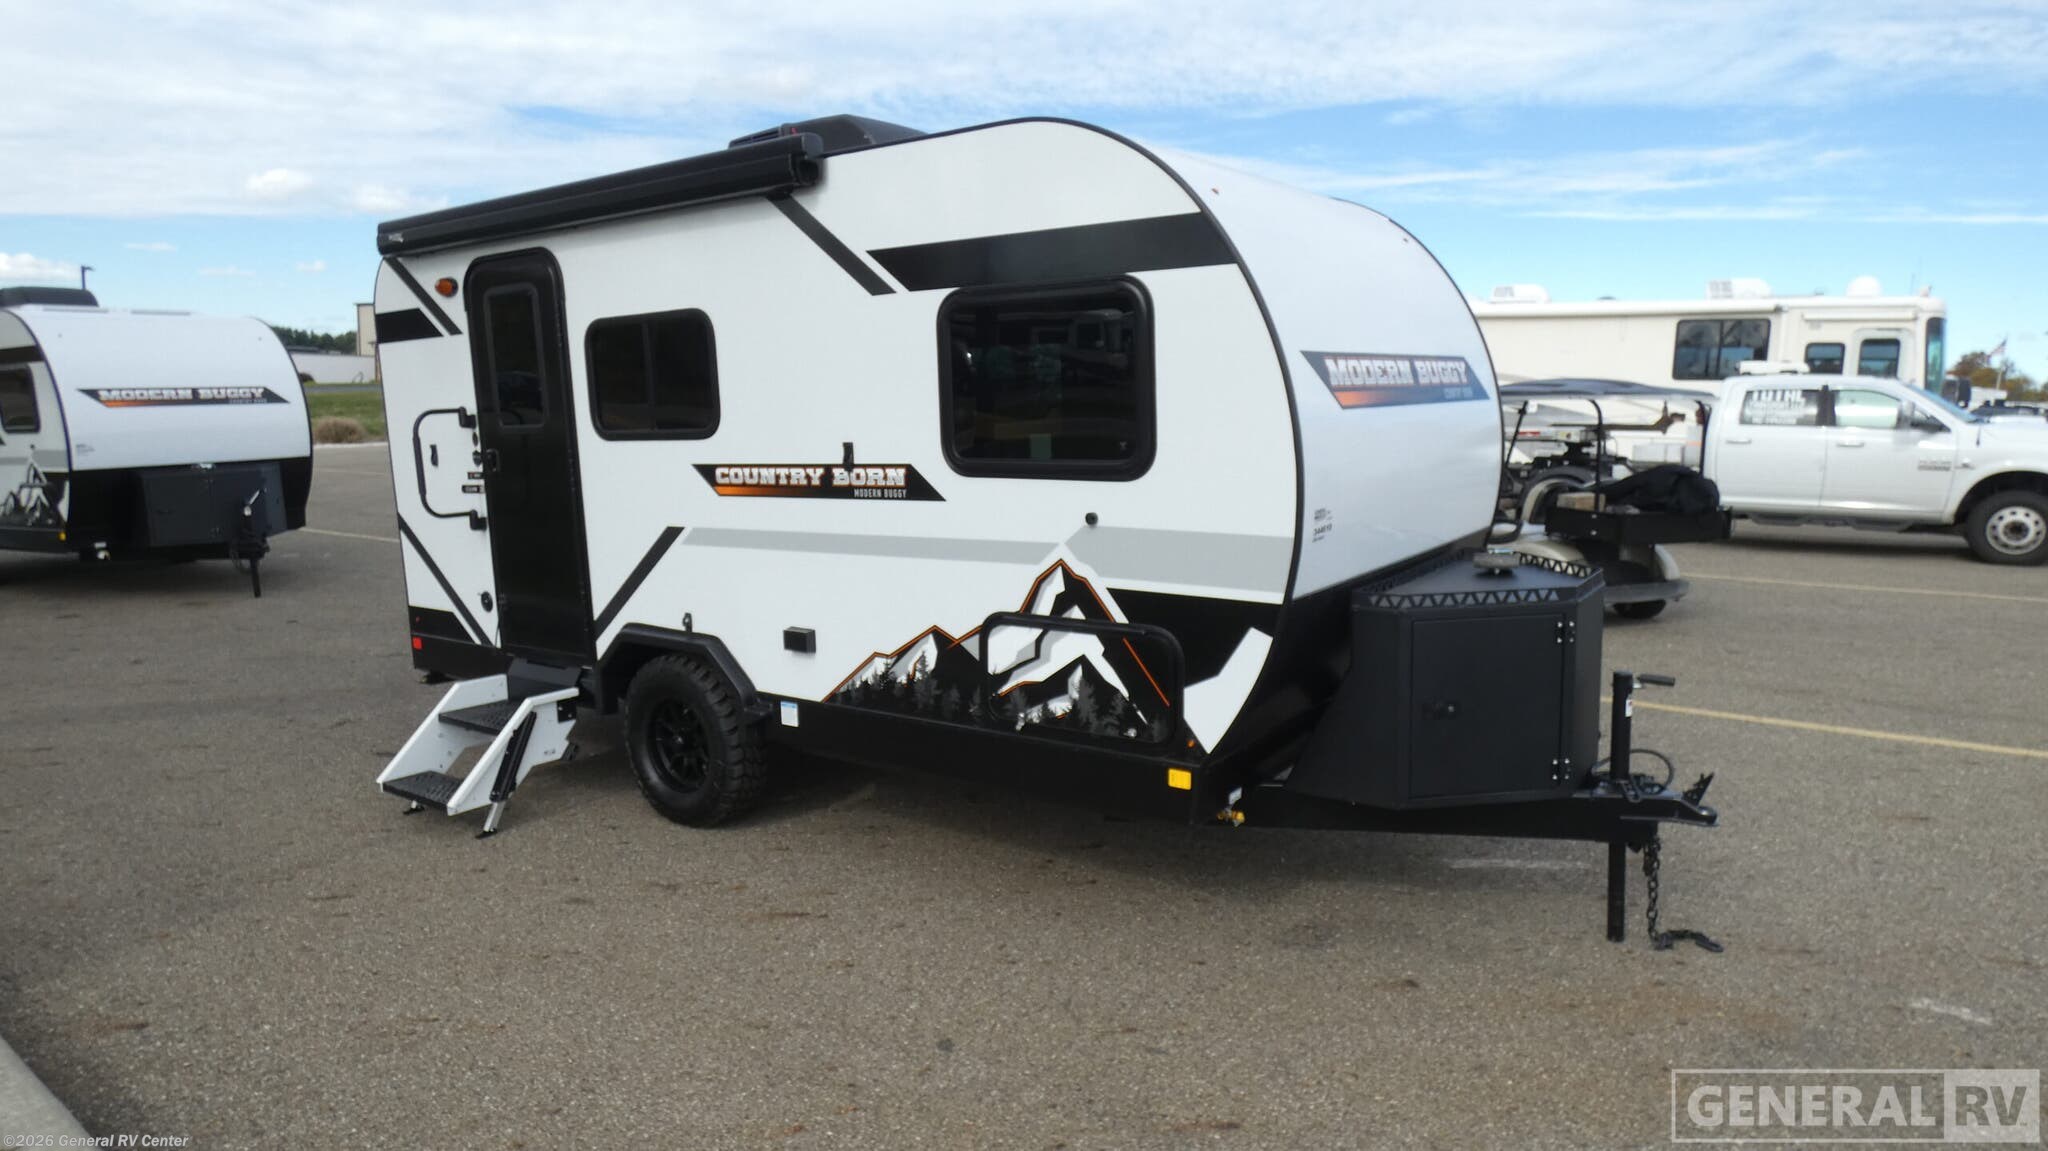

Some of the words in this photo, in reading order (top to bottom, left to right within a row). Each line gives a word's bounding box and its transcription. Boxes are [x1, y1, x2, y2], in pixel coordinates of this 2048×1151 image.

[1323, 357, 1415, 386] MODERN
[1414, 359, 1469, 385] BUGGY
[97, 389, 193, 401] MODERN
[197, 387, 265, 400] BUGGY
[715, 466, 825, 486] COUNTRY
[832, 467, 907, 487] BORN
[853, 488, 882, 498] MODERN
[884, 488, 907, 499] BUGGY
